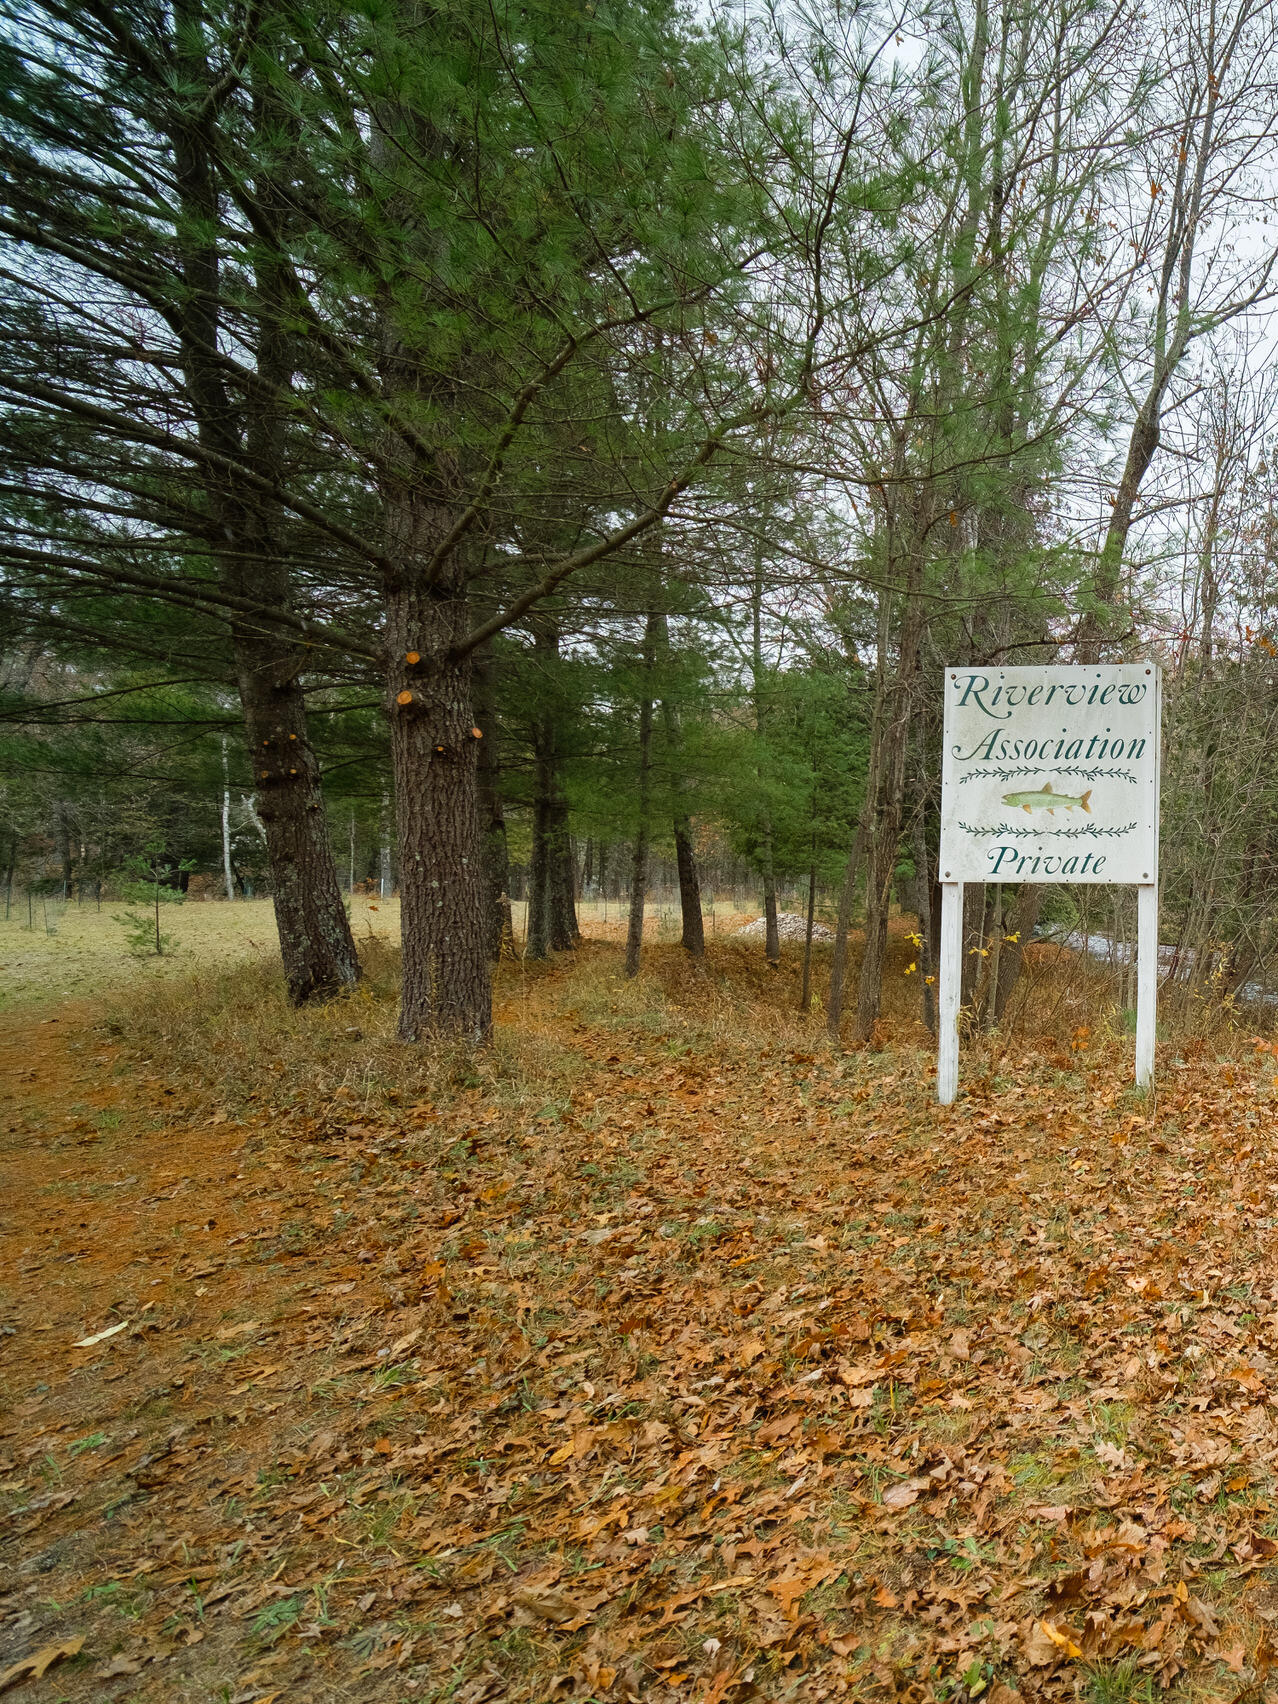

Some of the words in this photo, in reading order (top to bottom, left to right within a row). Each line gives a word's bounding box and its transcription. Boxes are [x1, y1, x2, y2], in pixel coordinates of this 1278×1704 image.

[953, 673, 1147, 720] Riverview
[951, 727, 1146, 761] Association
[987, 846, 1107, 875] Private
